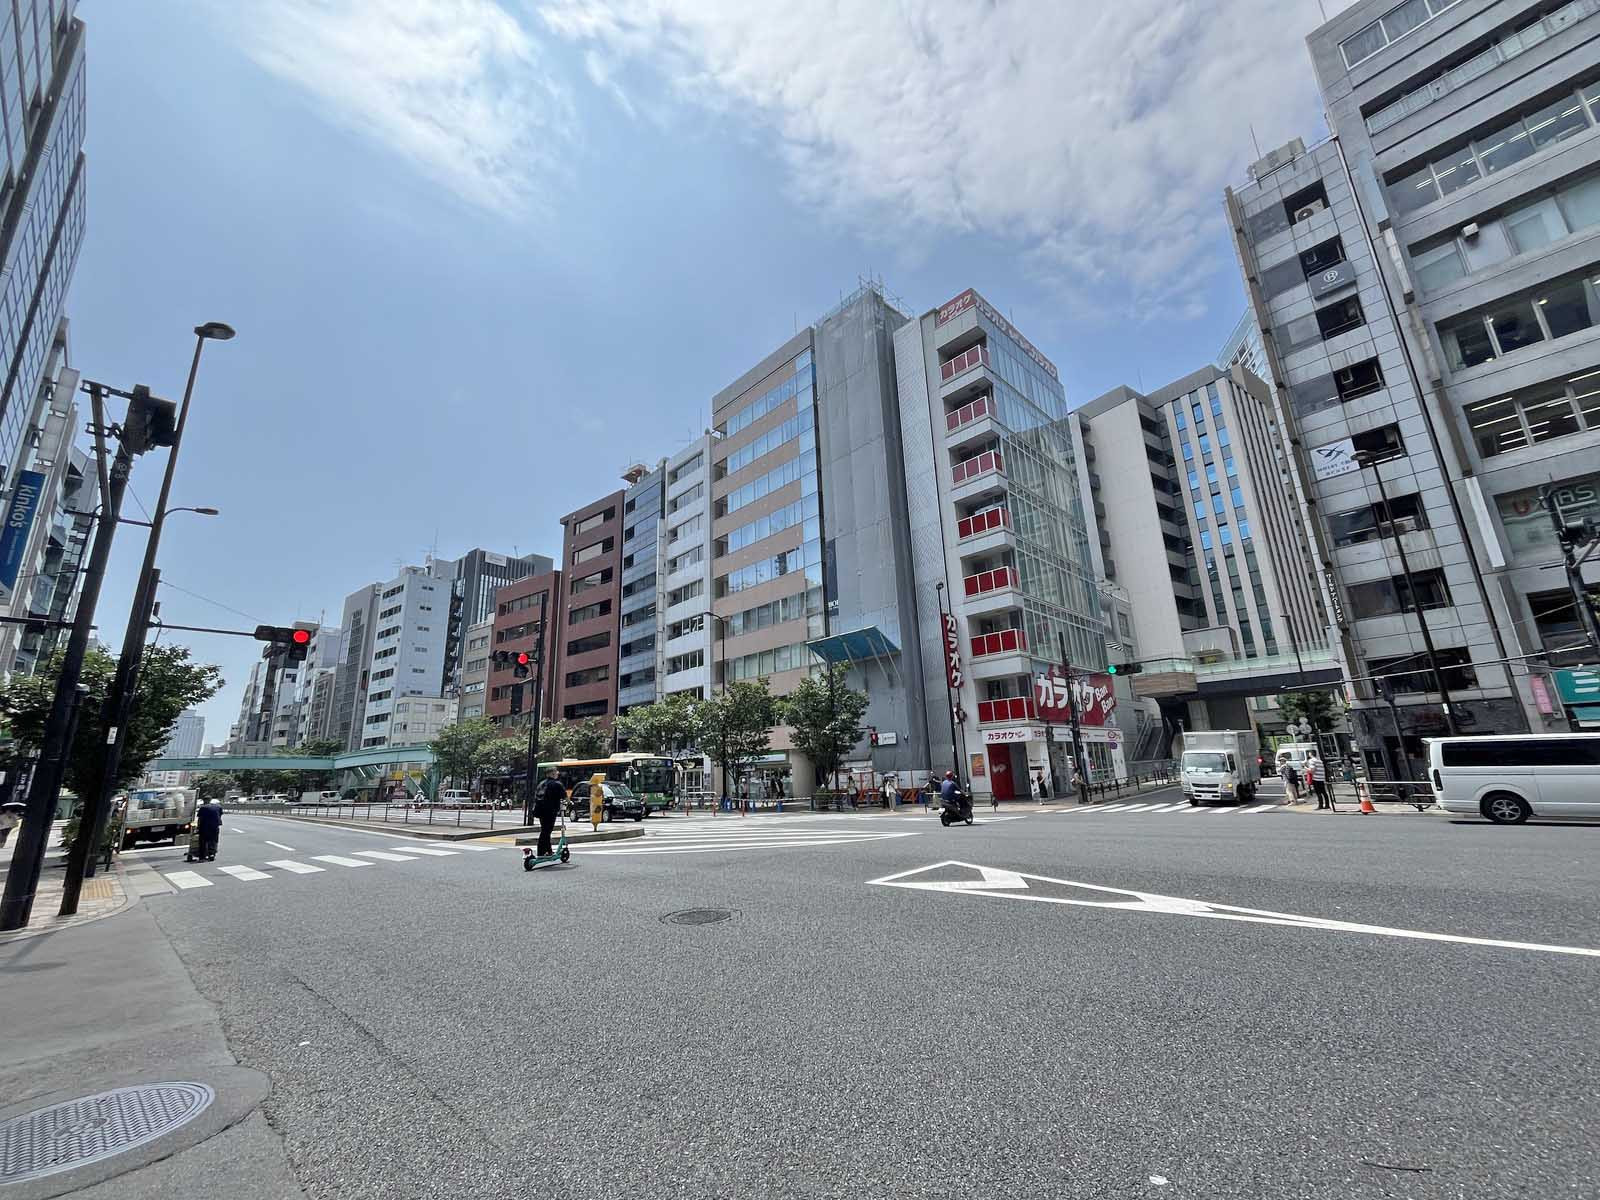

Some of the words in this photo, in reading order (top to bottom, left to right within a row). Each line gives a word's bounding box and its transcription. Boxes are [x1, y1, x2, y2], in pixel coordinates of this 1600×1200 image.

[939, 294, 972, 320] カラオケ
[946, 615, 962, 687] カラオケ
[1095, 685, 1108, 701] Ban
[1101, 697, 1114, 713] Ban
[987, 731, 1014, 740] カラオケ
